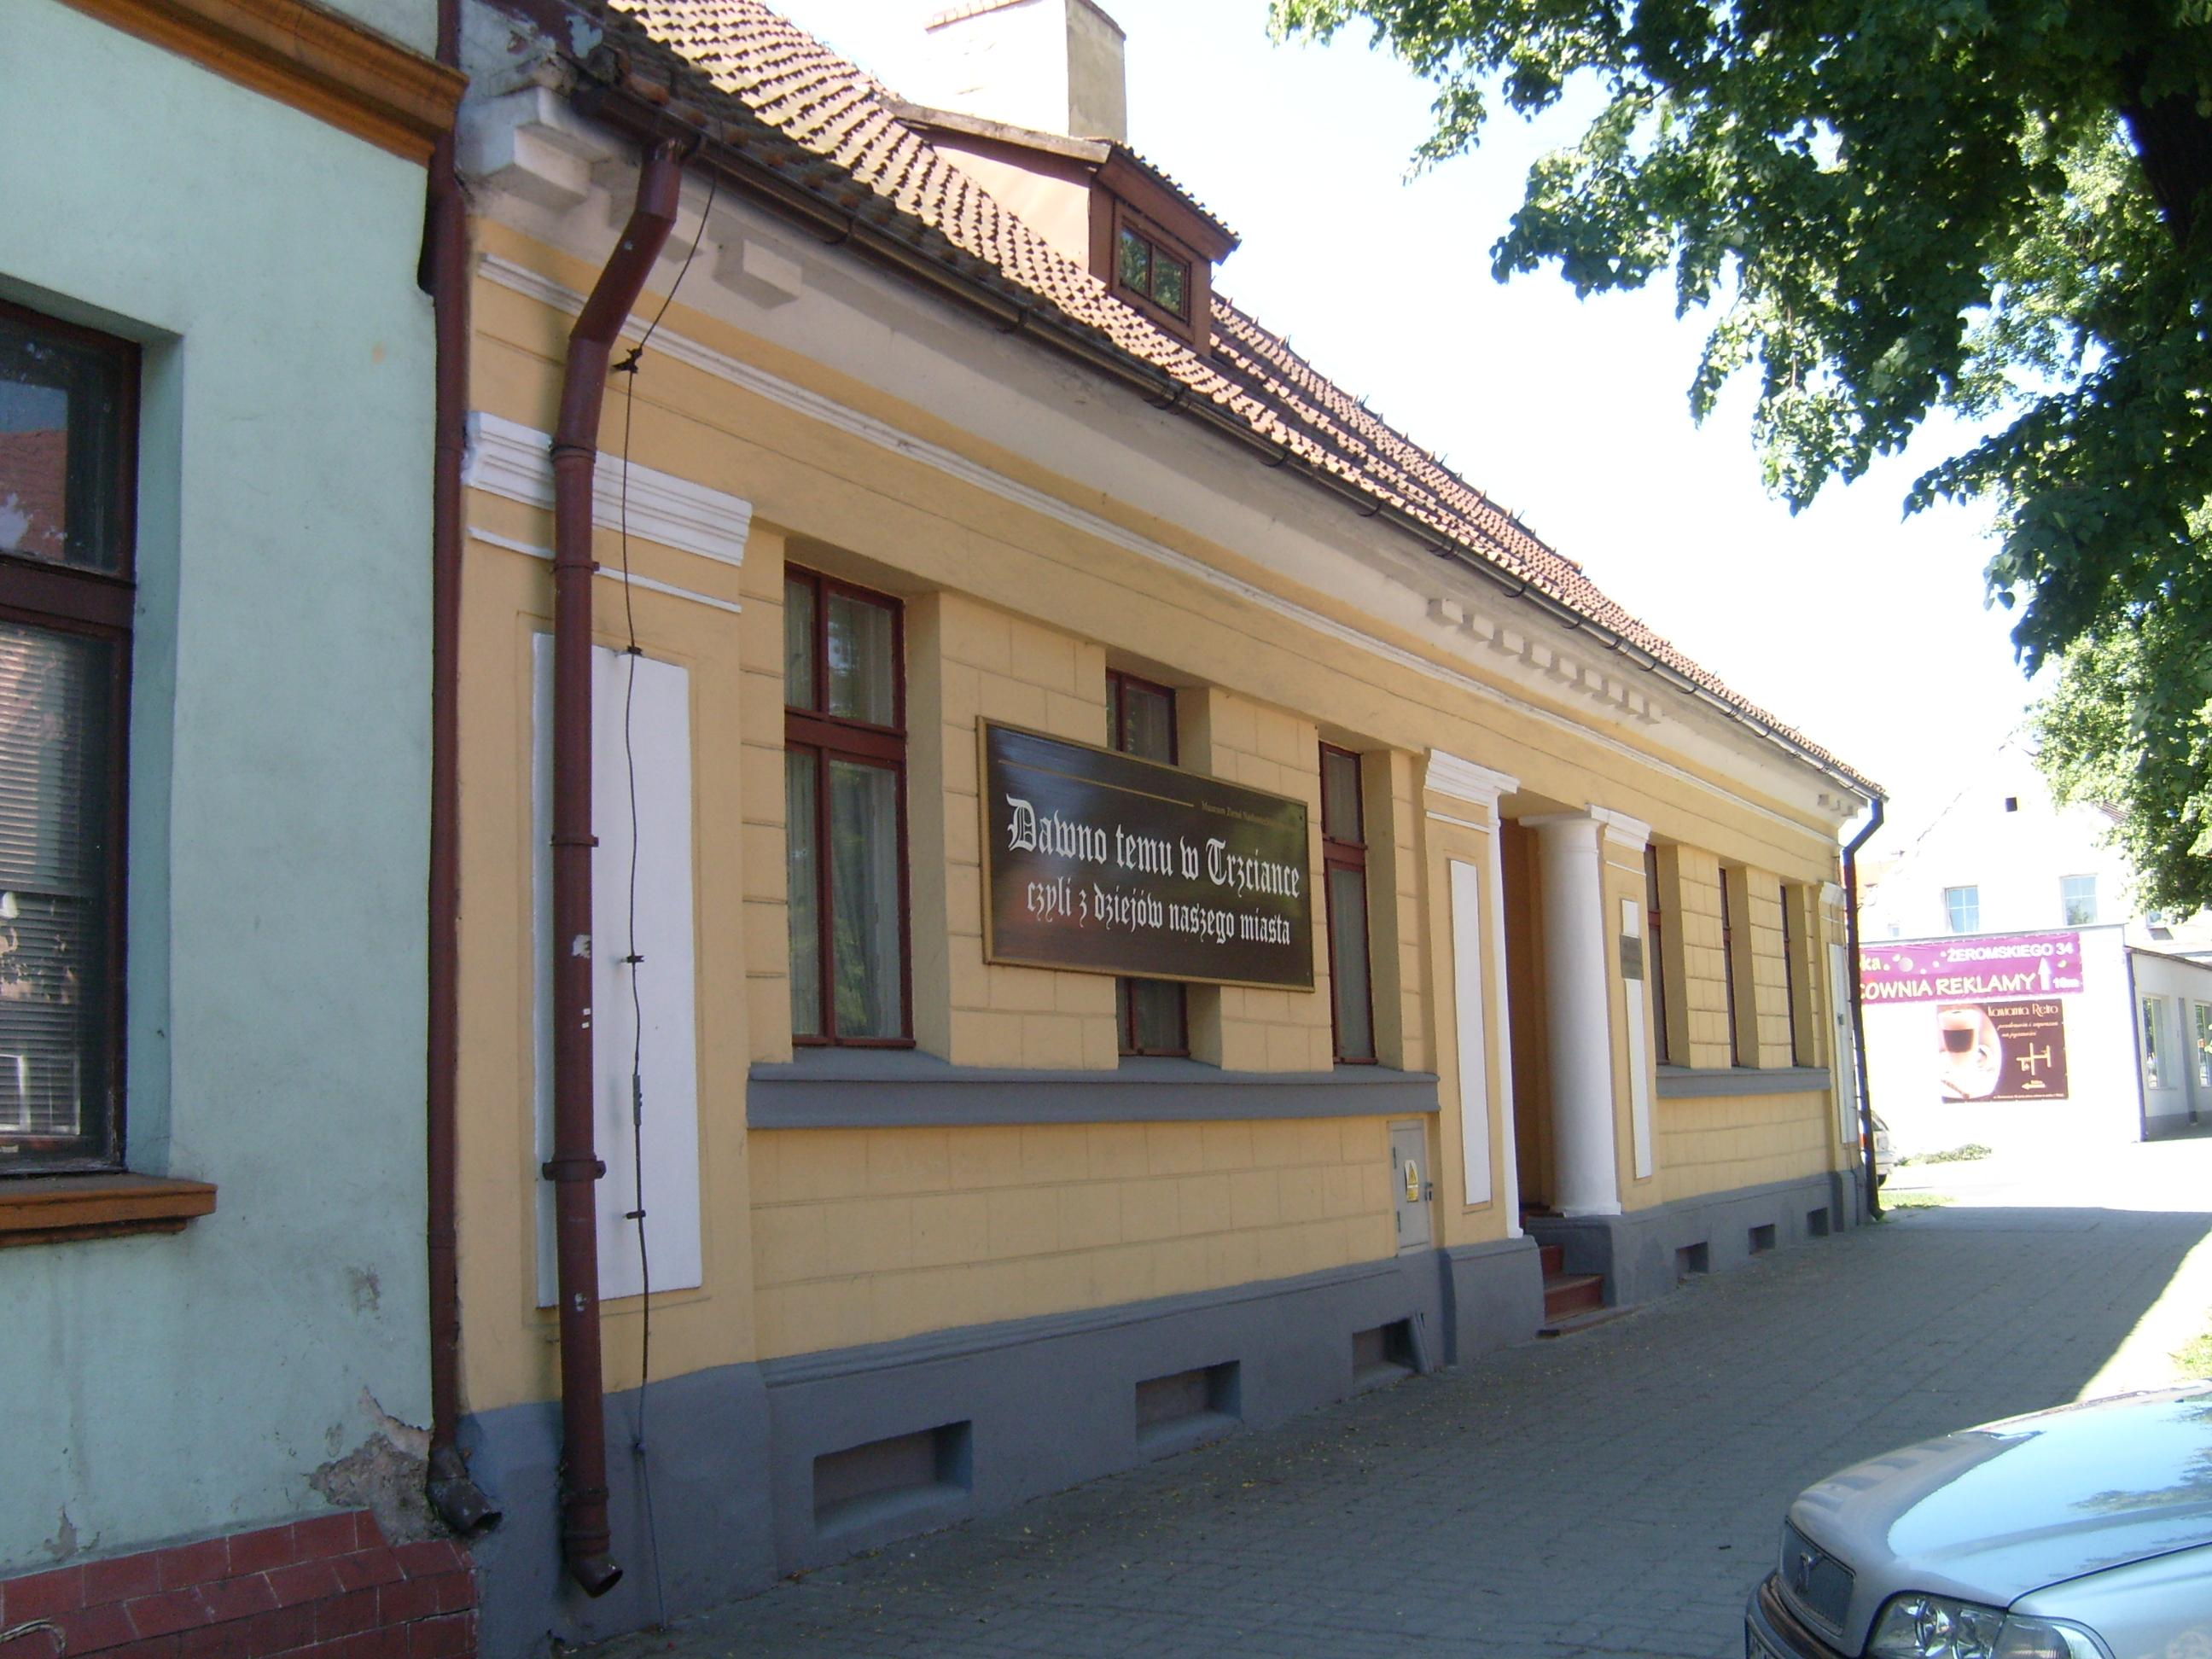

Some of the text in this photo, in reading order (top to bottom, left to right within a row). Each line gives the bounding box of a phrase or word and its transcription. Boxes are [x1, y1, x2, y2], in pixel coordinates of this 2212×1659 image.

[1006, 794, 1301, 899] Dawno temu w Trzciance
[1027, 876, 1290, 946] czyli z dziejów naszego miasta
[2056, 942, 2074, 955] 34
[1936, 973, 2036, 995] REKLAMY
